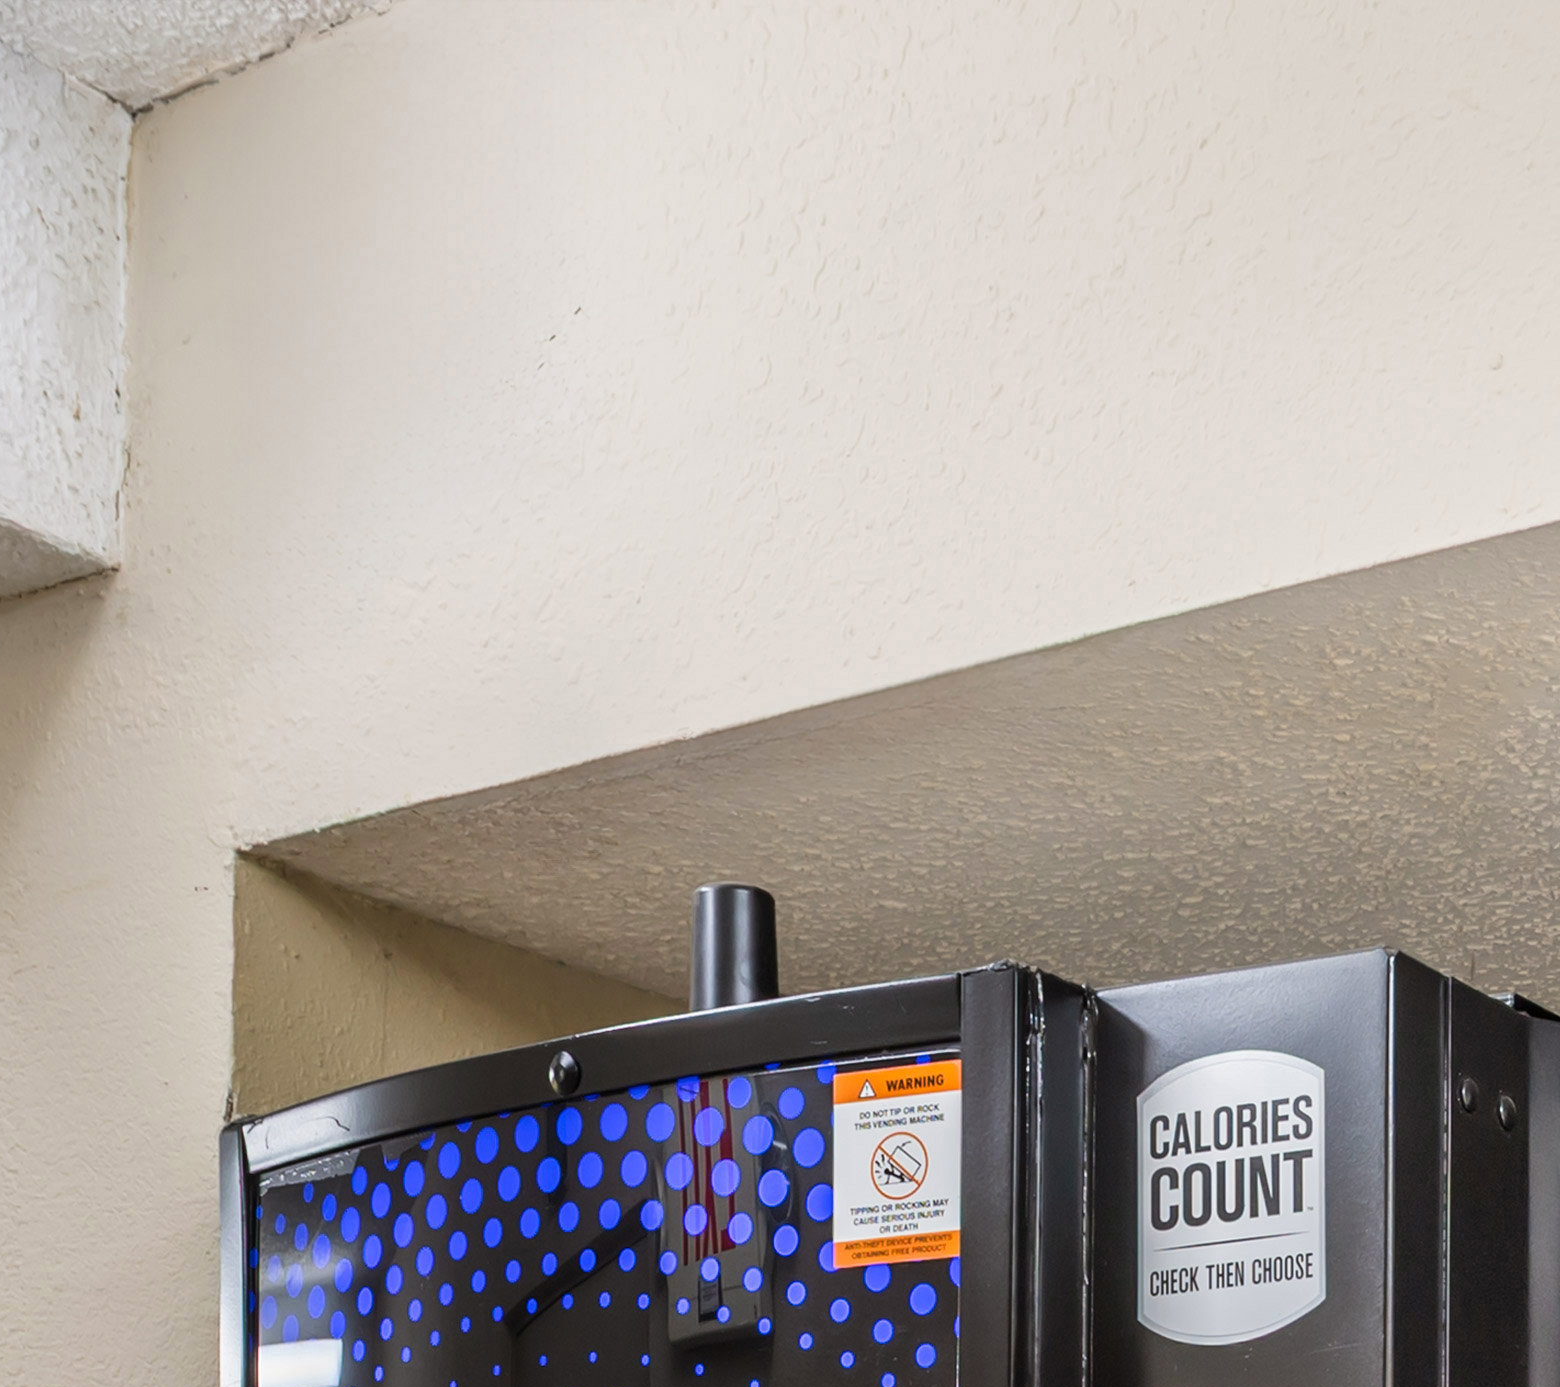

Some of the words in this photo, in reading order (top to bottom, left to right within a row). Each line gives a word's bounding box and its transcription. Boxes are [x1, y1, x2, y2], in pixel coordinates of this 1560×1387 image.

[886, 1074, 944, 1091] WARNING
[1150, 1095, 1313, 1159] CALORIES
[1151, 1149, 1313, 1231] COUNT
[1150, 1266, 1200, 1296] CHECK
[1206, 1261, 1245, 1290] THEN
[1252, 1252, 1313, 1285] CHOOSE
